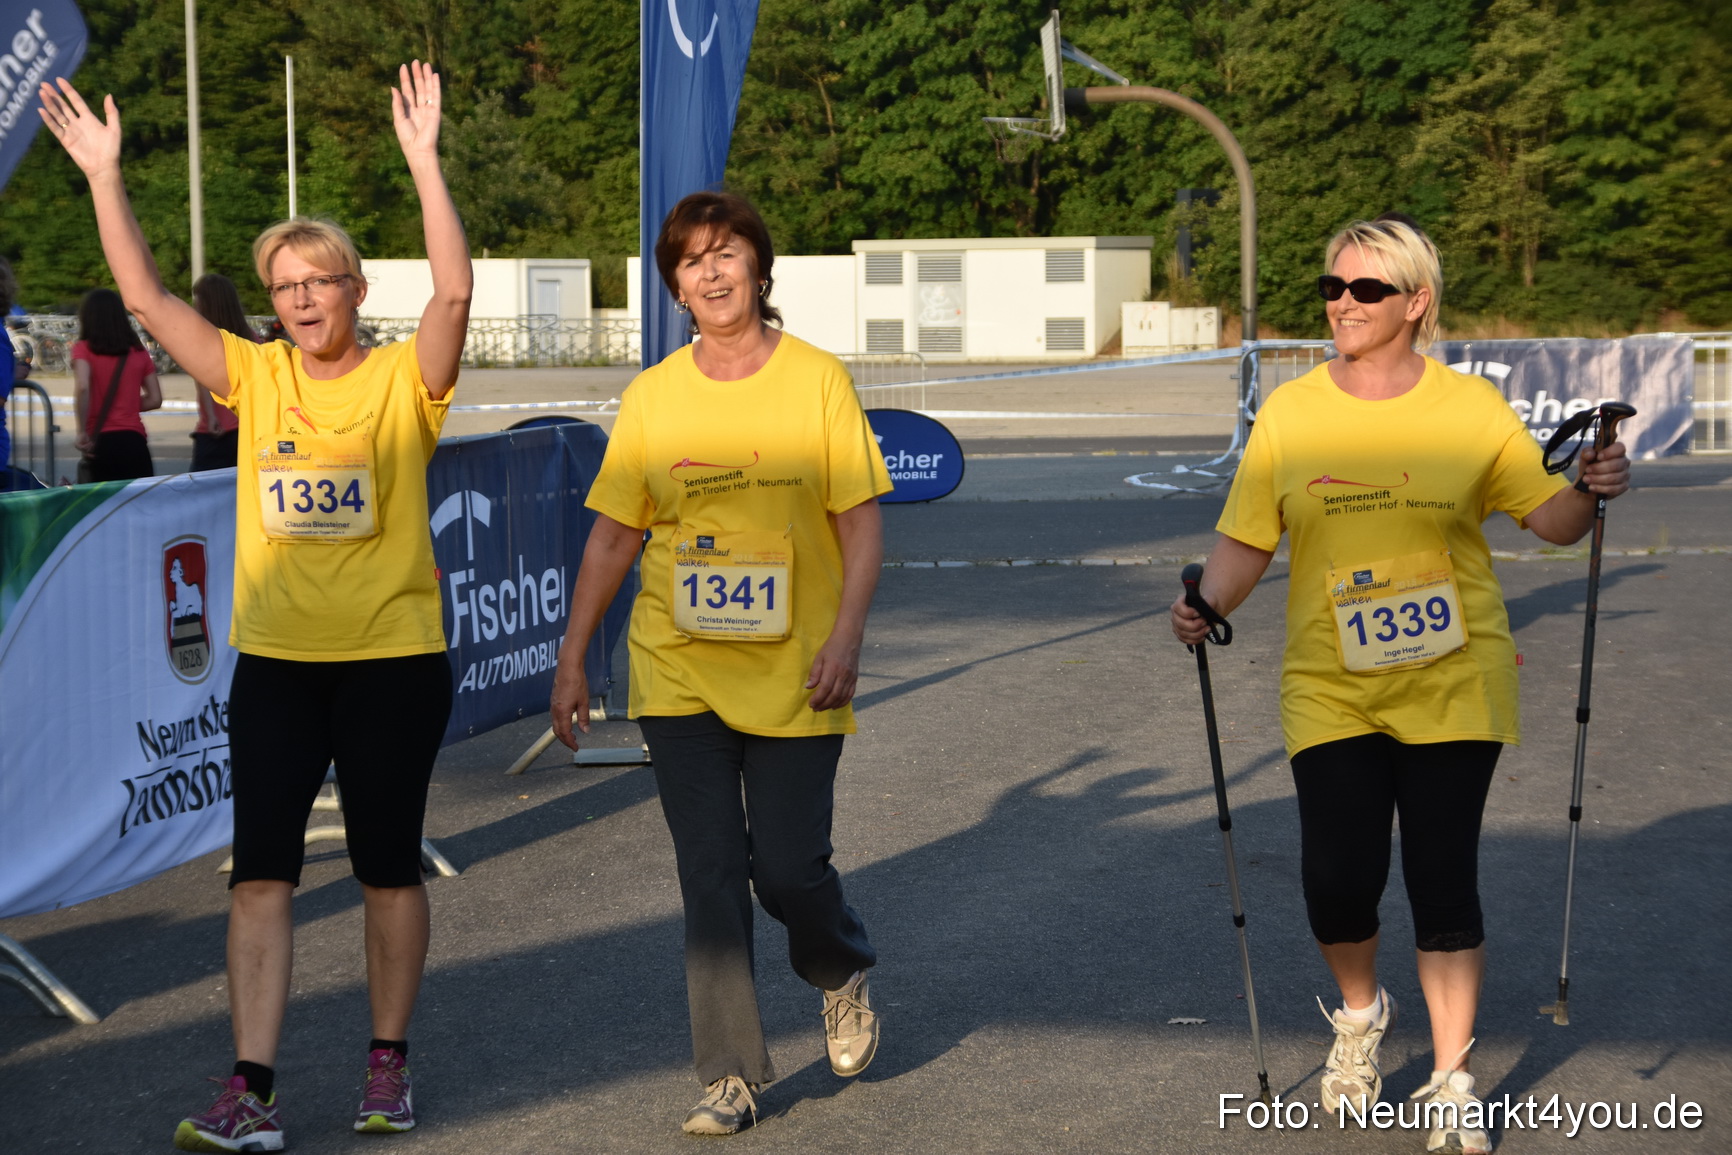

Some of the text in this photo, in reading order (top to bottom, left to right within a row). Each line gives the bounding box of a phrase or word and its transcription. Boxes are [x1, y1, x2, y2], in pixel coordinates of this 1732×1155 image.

[270, 452, 312, 461] firmenlauf
[684, 470, 744, 488] Seniorenstift
[888, 471, 937, 480] MOBILE
[686, 477, 802, 499] am Tiroler Hof Neumarkt
[269, 479, 365, 513] 1334
[1323, 490, 1391, 505] Seniorenstift
[1325, 499, 1456, 516] am Tiroler Hof Neumarkt
[688, 547, 730, 557] firmenlauf
[677, 558, 709, 568] walken
[683, 573, 774, 610] 1341
[1346, 578, 1391, 593] firmenlauf
[1336, 595, 1372, 608] walken
[697, 616, 762, 627] Christa Weininger
[1347, 596, 1451, 646] 1339
[1384, 644, 1425, 657] Inge Hegel
[179, 648, 203, 670] 1628
